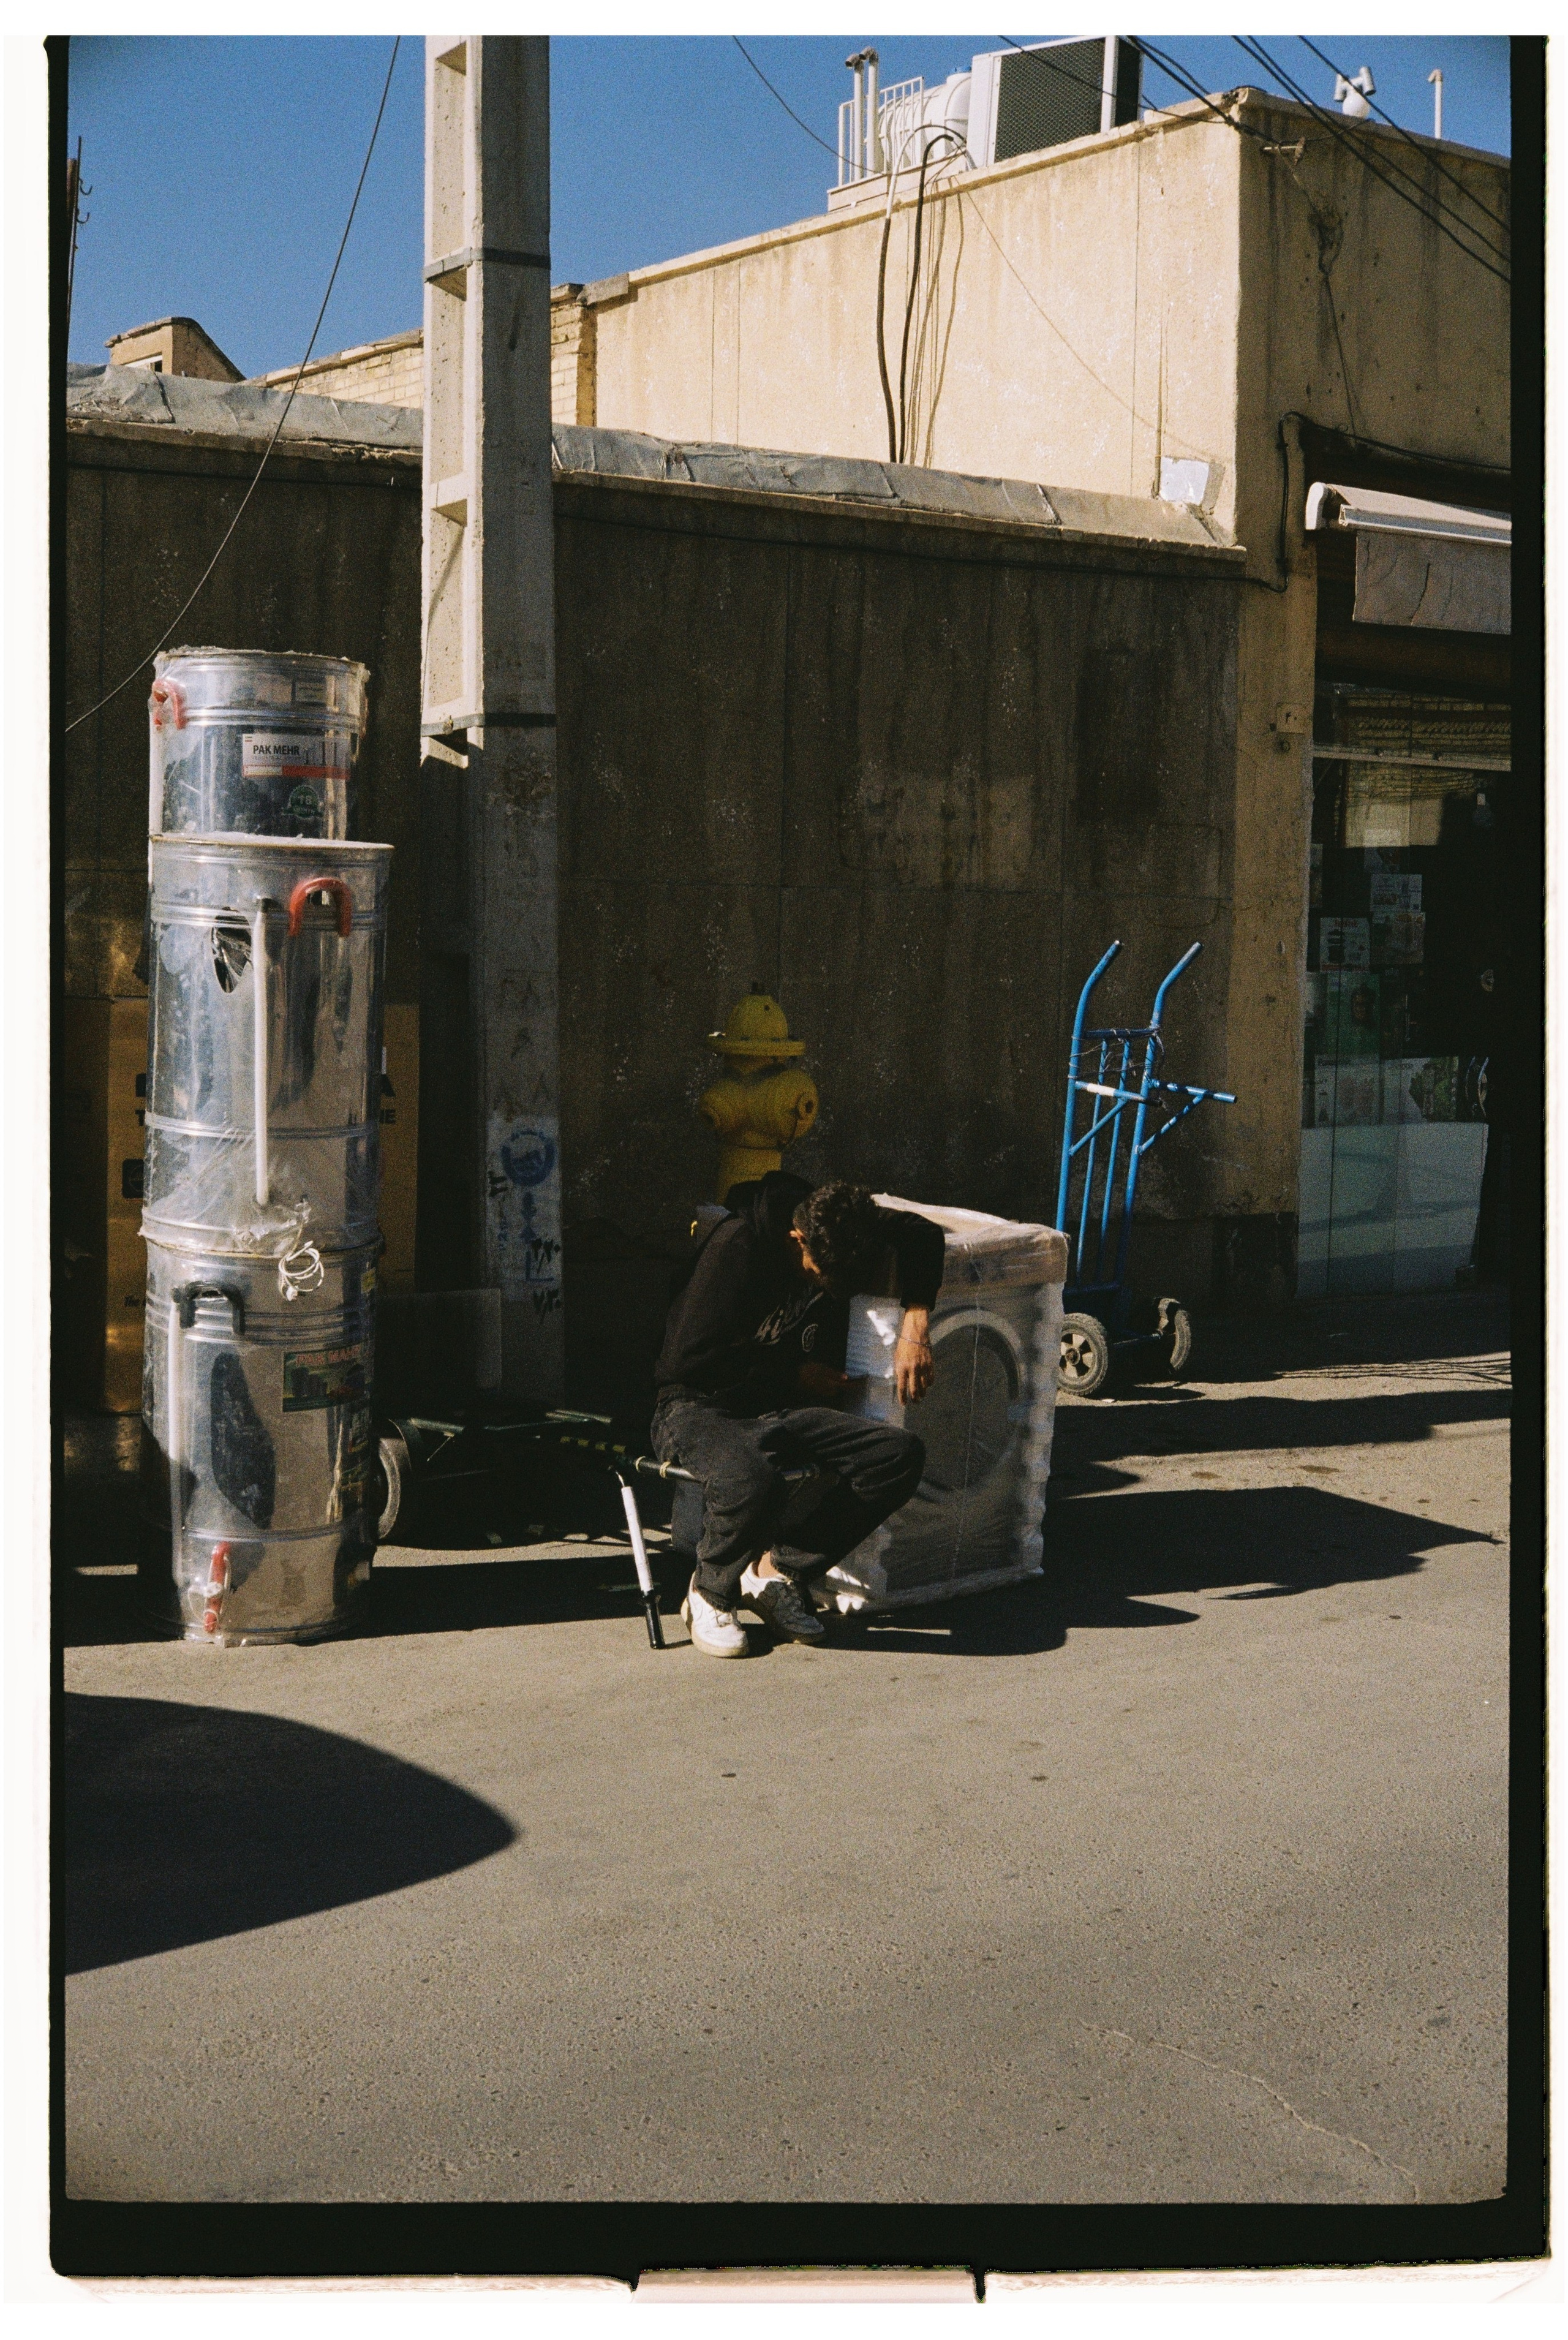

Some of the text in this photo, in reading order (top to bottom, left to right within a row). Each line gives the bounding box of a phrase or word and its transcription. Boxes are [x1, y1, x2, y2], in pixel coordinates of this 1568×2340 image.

[253, 744, 271, 755] PAK
[273, 745, 300, 755] MEHR
[296, 1354, 326, 1365] PAK
